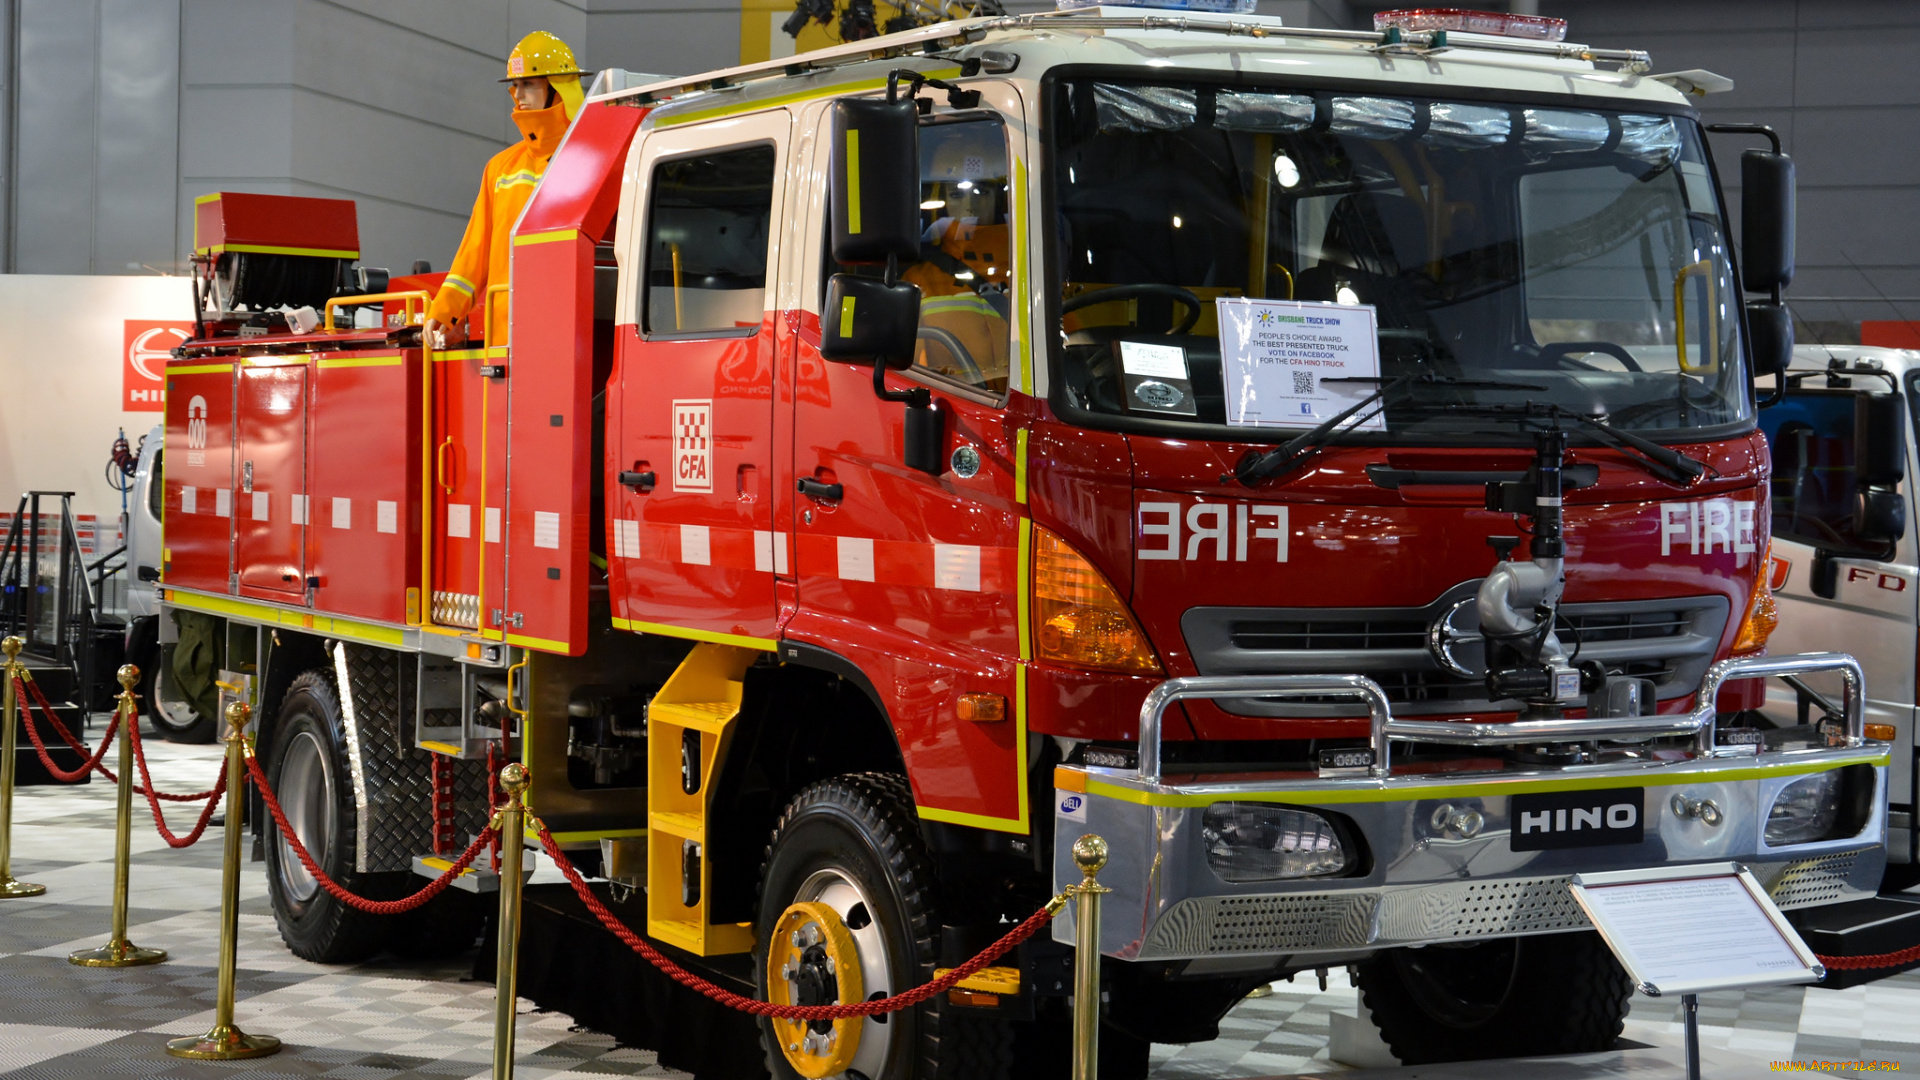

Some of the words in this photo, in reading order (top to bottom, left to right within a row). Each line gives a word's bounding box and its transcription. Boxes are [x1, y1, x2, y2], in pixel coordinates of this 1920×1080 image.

[1278, 315, 1305, 323] BRISBANE
[1286, 342, 1325, 350] PRESENTED
[131, 389, 165, 402] HI
[679, 454, 706, 479] CFA
[1659, 500, 1756, 556] FIRE
[1847, 567, 1906, 592] FD
[1521, 803, 1637, 834] HINO
